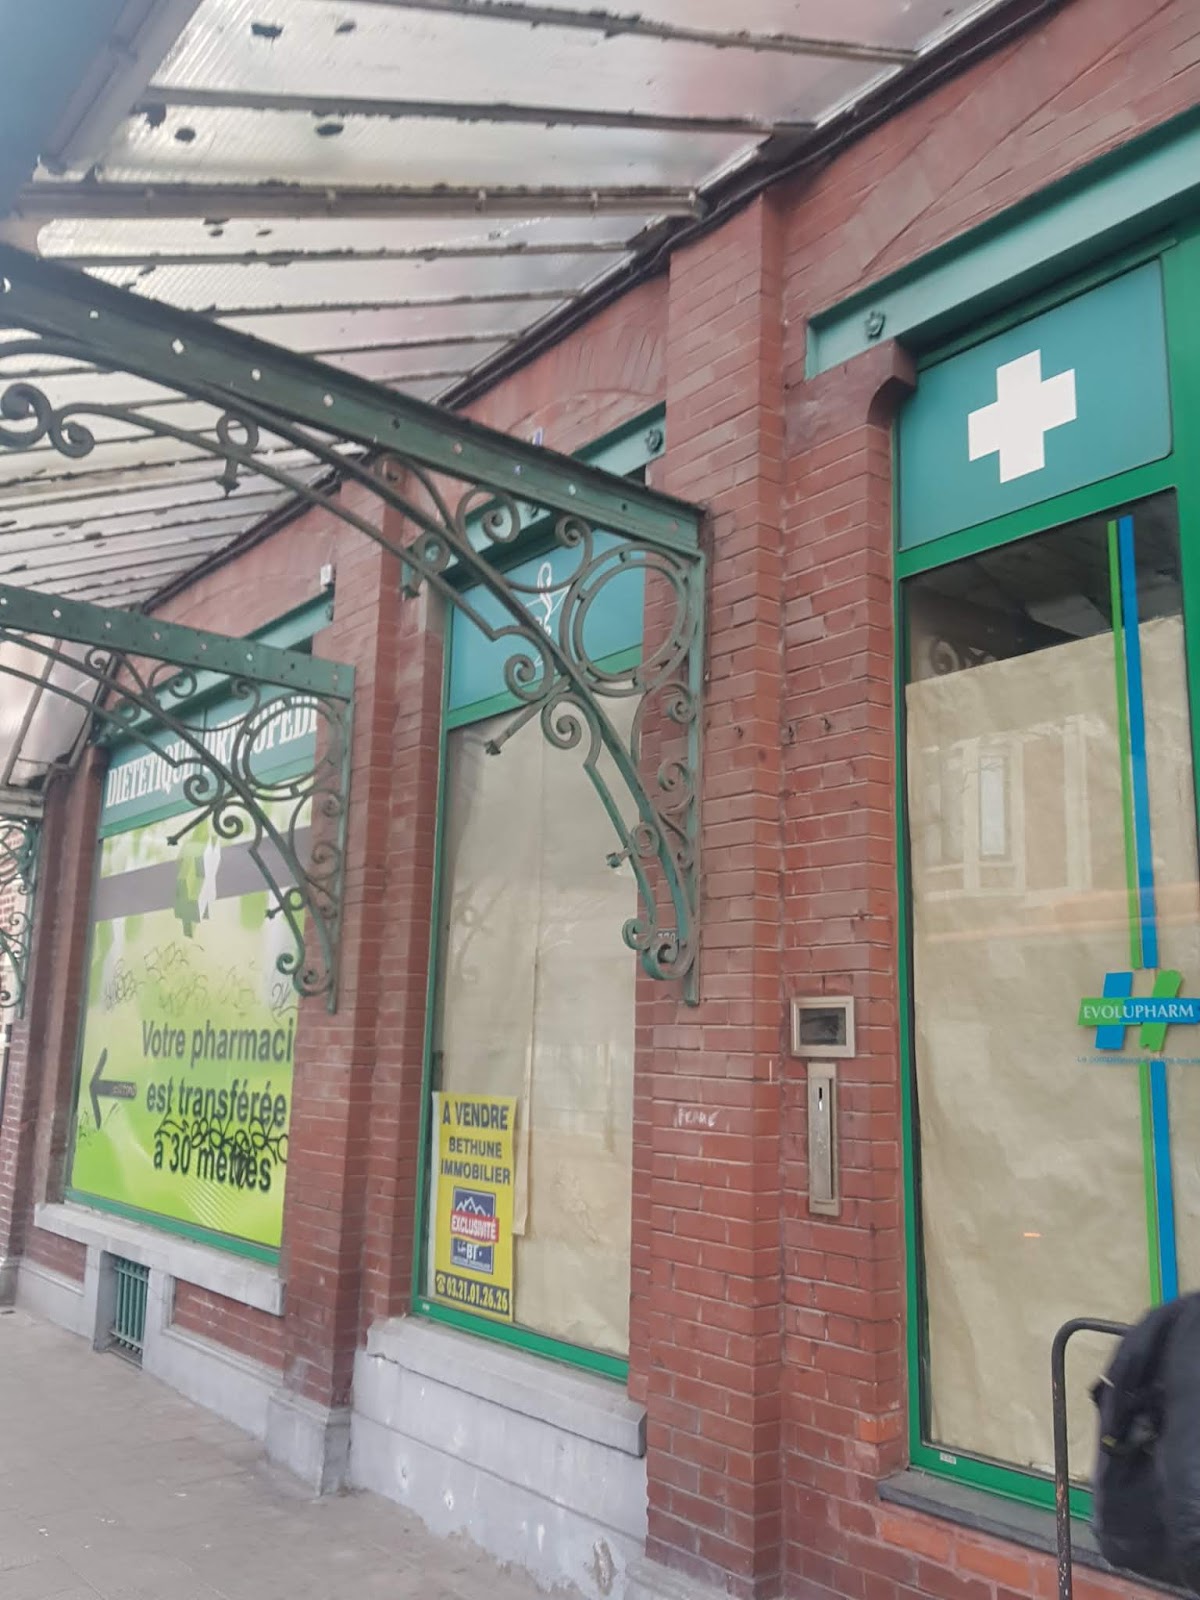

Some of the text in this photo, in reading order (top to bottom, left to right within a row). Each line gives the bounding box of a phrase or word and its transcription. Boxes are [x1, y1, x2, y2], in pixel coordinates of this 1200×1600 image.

[1083, 1004, 1194, 1019] EVOLUPHARM
[142, 1017, 294, 1069] Votre pharmaci
[147, 1076, 287, 1127] est transférée
[442, 1101, 509, 1130] A VENDRE
[169, 1132, 191, 1175] 30
[449, 1136, 502, 1158] BETHUNE
[440, 1159, 511, 1185] IMMOBILIER
[451, 1214, 496, 1240] EXCLUSIVITÉ
[446, 1276, 508, 1312] 03.21.01.26.26
